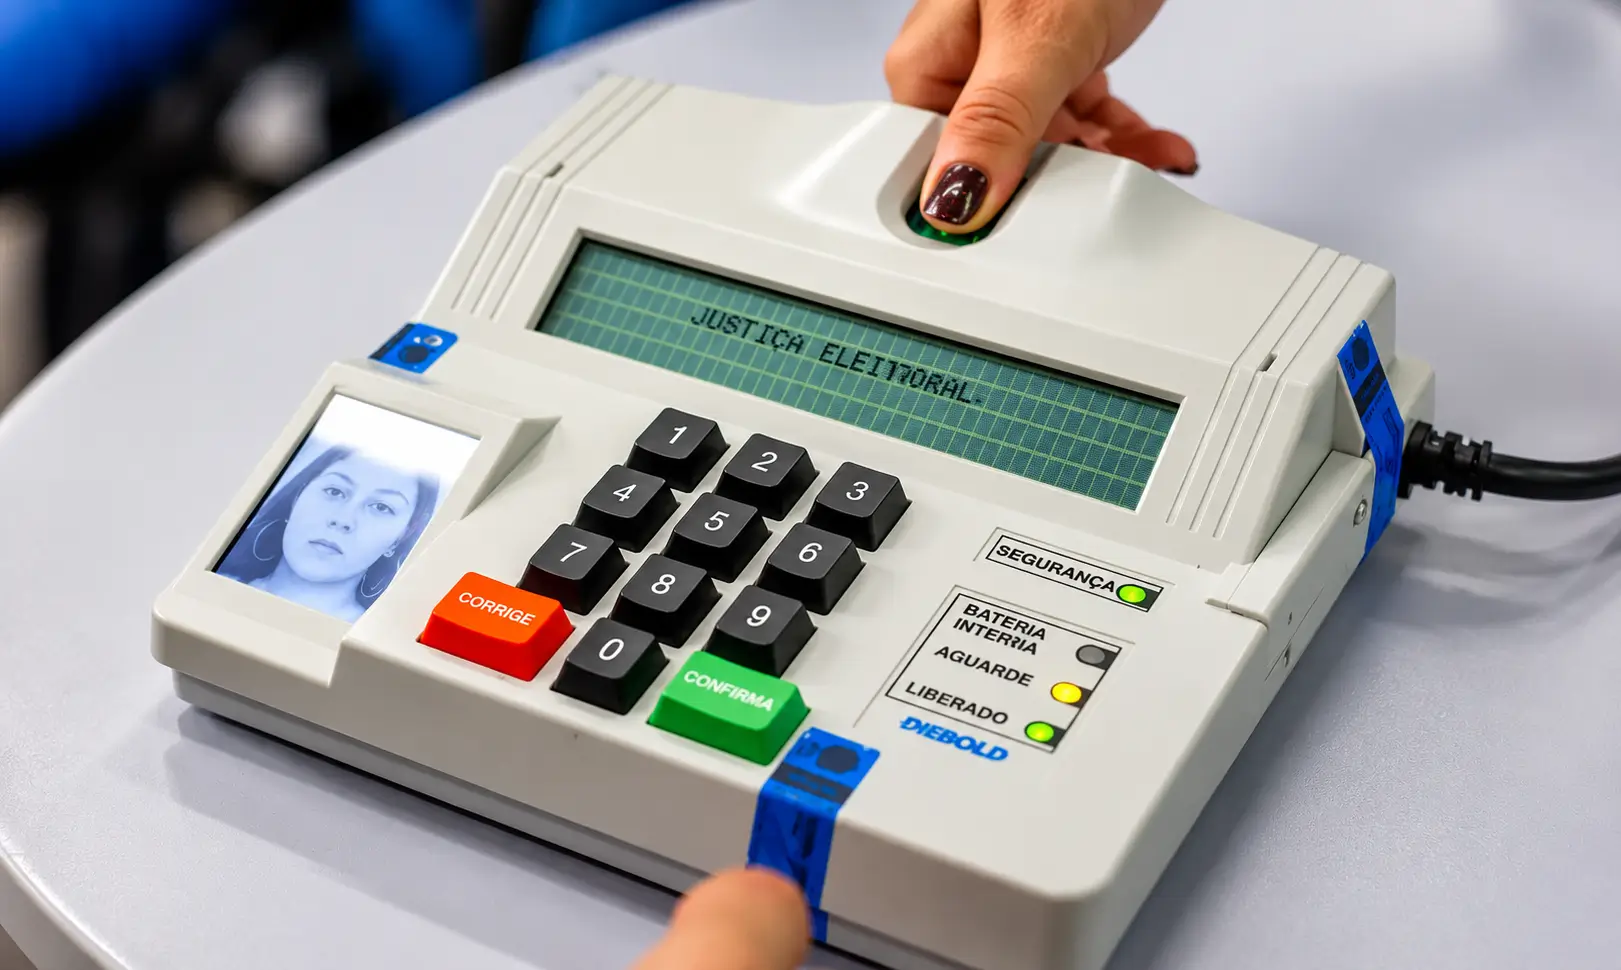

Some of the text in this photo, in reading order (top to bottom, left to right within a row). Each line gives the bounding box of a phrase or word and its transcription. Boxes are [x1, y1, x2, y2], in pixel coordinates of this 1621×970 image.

[690, 307, 804, 353] JUSTIÇA
[669, 425, 688, 445] 1
[751, 451, 778, 473] 2
[612, 483, 637, 502] 4
[845, 481, 870, 501] 3
[703, 510, 730, 532] 5
[559, 541, 588, 563] 7
[798, 542, 823, 563] 6
[996, 545, 1115, 592] SEGURANÇA
[650, 573, 676, 595] 8
[458, 592, 536, 626] CORRIGE
[746, 605, 772, 627] 9
[963, 603, 1046, 640] BATERIA
[598, 638, 625, 661] 0
[934, 646, 1034, 687] AGUARDE
[683, 670, 774, 712] CONFIRMA
[905, 682, 1009, 725] LIBERADO
[900, 716, 1009, 761] DIEBOLD
